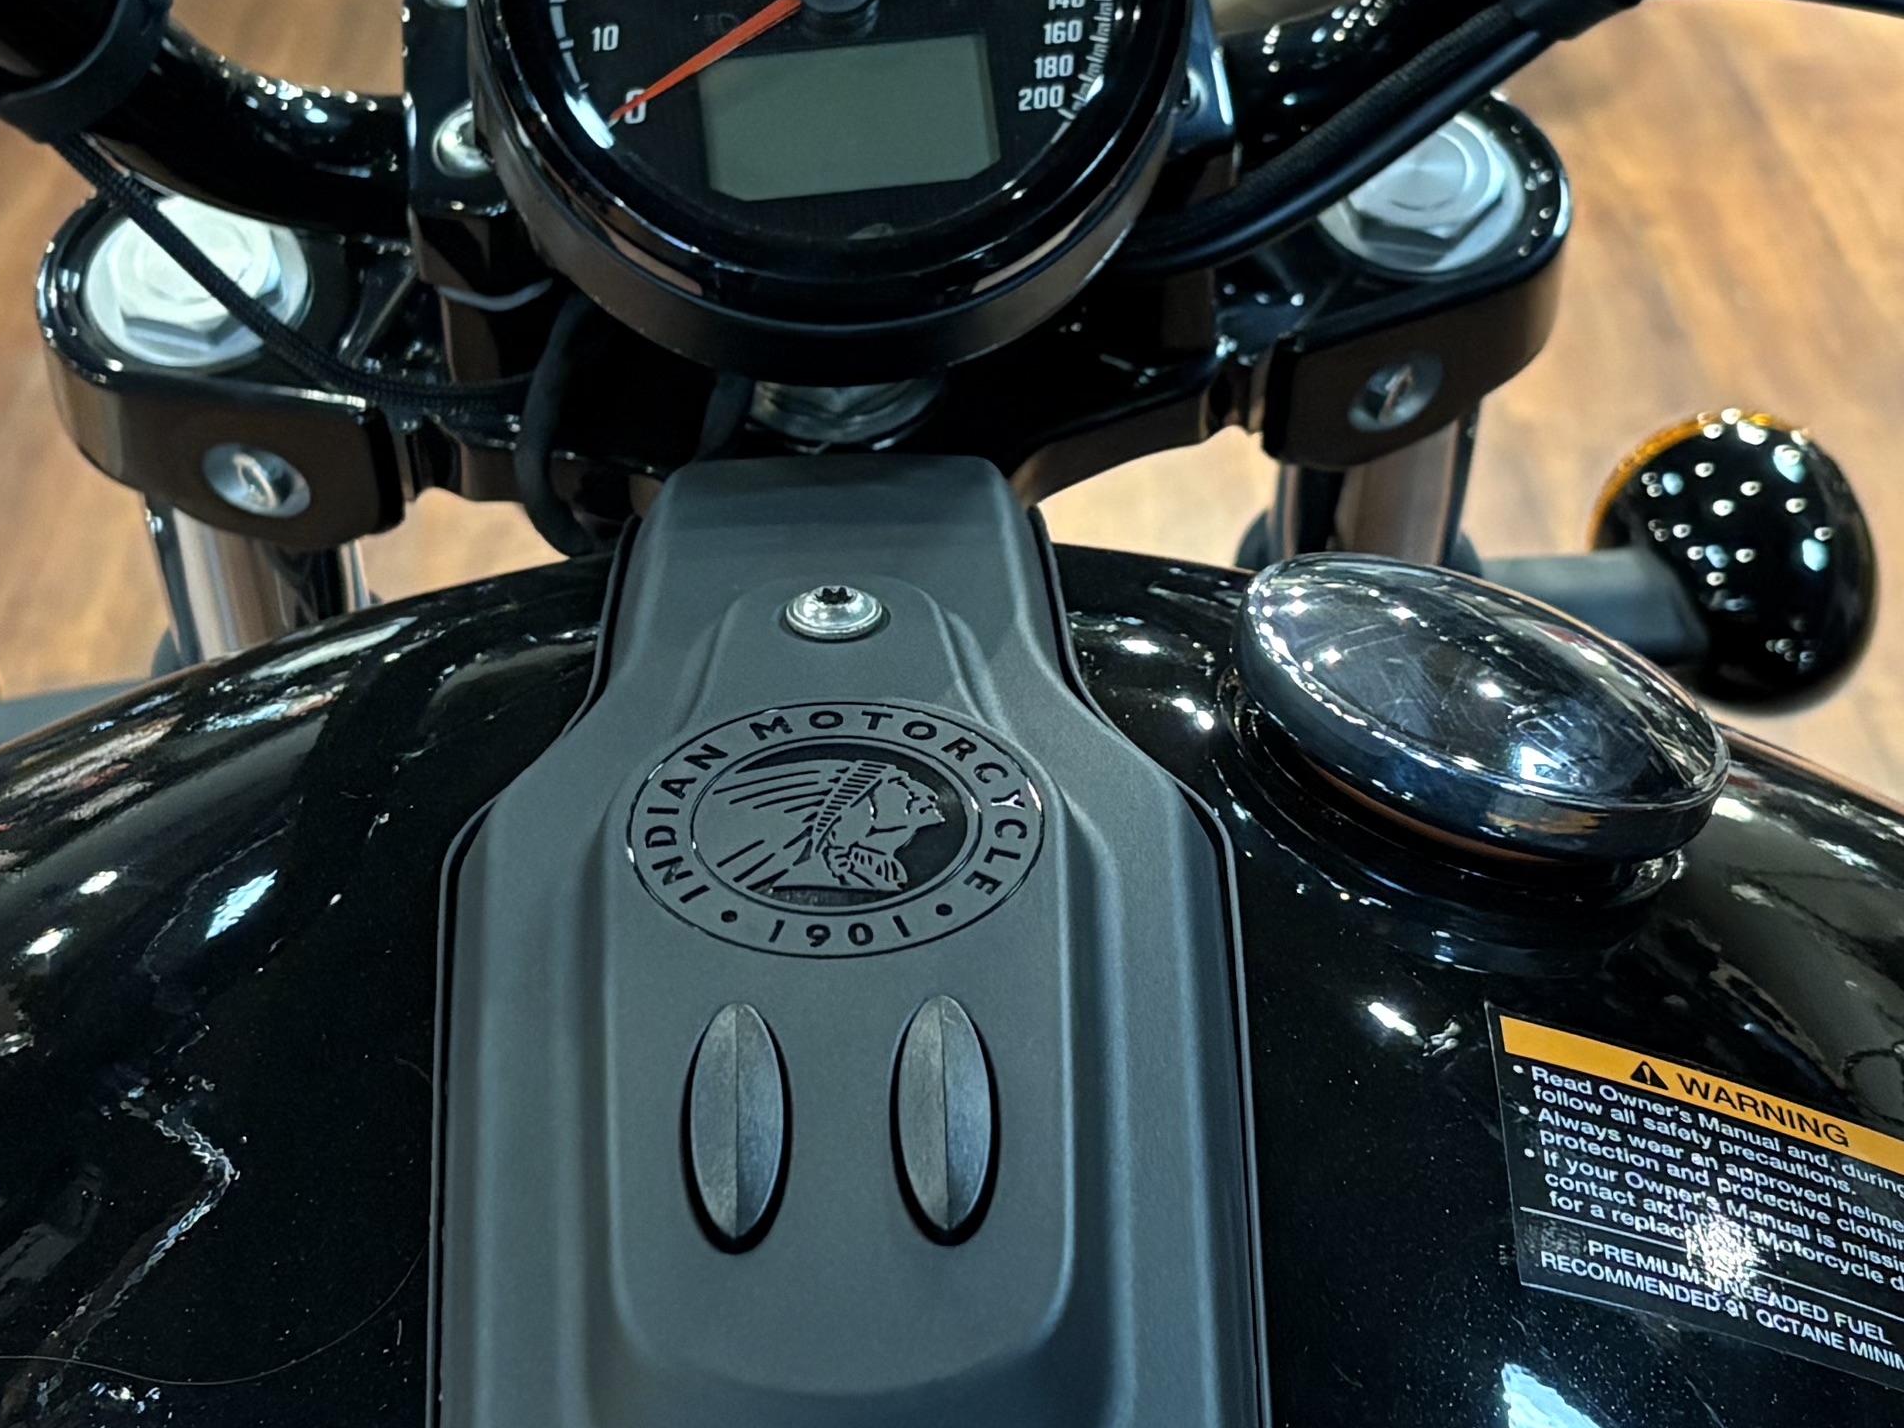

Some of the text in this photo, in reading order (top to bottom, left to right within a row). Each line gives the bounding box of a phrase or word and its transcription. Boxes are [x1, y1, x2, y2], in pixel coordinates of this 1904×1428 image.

[591, 25, 620, 52] 10
[1034, 53, 1075, 79] 180
[1043, 20, 1083, 45] 160
[1017, 86, 1064, 112] 200
[644, 708, 1028, 905] INDIAN MOTORCYCLE
[768, 915, 913, 948] 1901
[1531, 1065, 1592, 1096] Read
[1599, 1084, 1693, 1124] Owner's
[1698, 1113, 1780, 1152] Manual
[1533, 1085, 1857, 1195] follow all safety precautions.
[1677, 1073, 1849, 1147] WARNING
[1538, 1107, 1622, 1143] Always
[1627, 1133, 1684, 1160] wear
[1690, 1152, 1719, 1171] an
[1725, 1162, 1831, 1208] approved
[1540, 1129, 1660, 1172] protection
[1667, 1162, 1711, 1187] and
[1717, 1177, 1831, 1226] protective
[1543, 1149, 1560, 1168] If
[1565, 1157, 1619, 1184] your
[1624, 1170, 1721, 1212] Owner's
[1727, 1199, 1811, 1241] Manual
[1816, 1228, 1837, 1249] is
[1544, 1173, 1637, 1207] contact
[1757, 1227, 1884, 1284] Motorcycle
[1549, 1190, 1584, 1213] for
[1590, 1203, 1606, 1219] a
[1540, 1250, 1721, 1312] RECOMMENDED
[1725, 1298, 1748, 1320] 91
[1756, 1308, 1847, 1352] OCTANE
[1587, 1239, 1700, 1285] PREMIUM
[1834, 1312, 1894, 1346] FUEL
